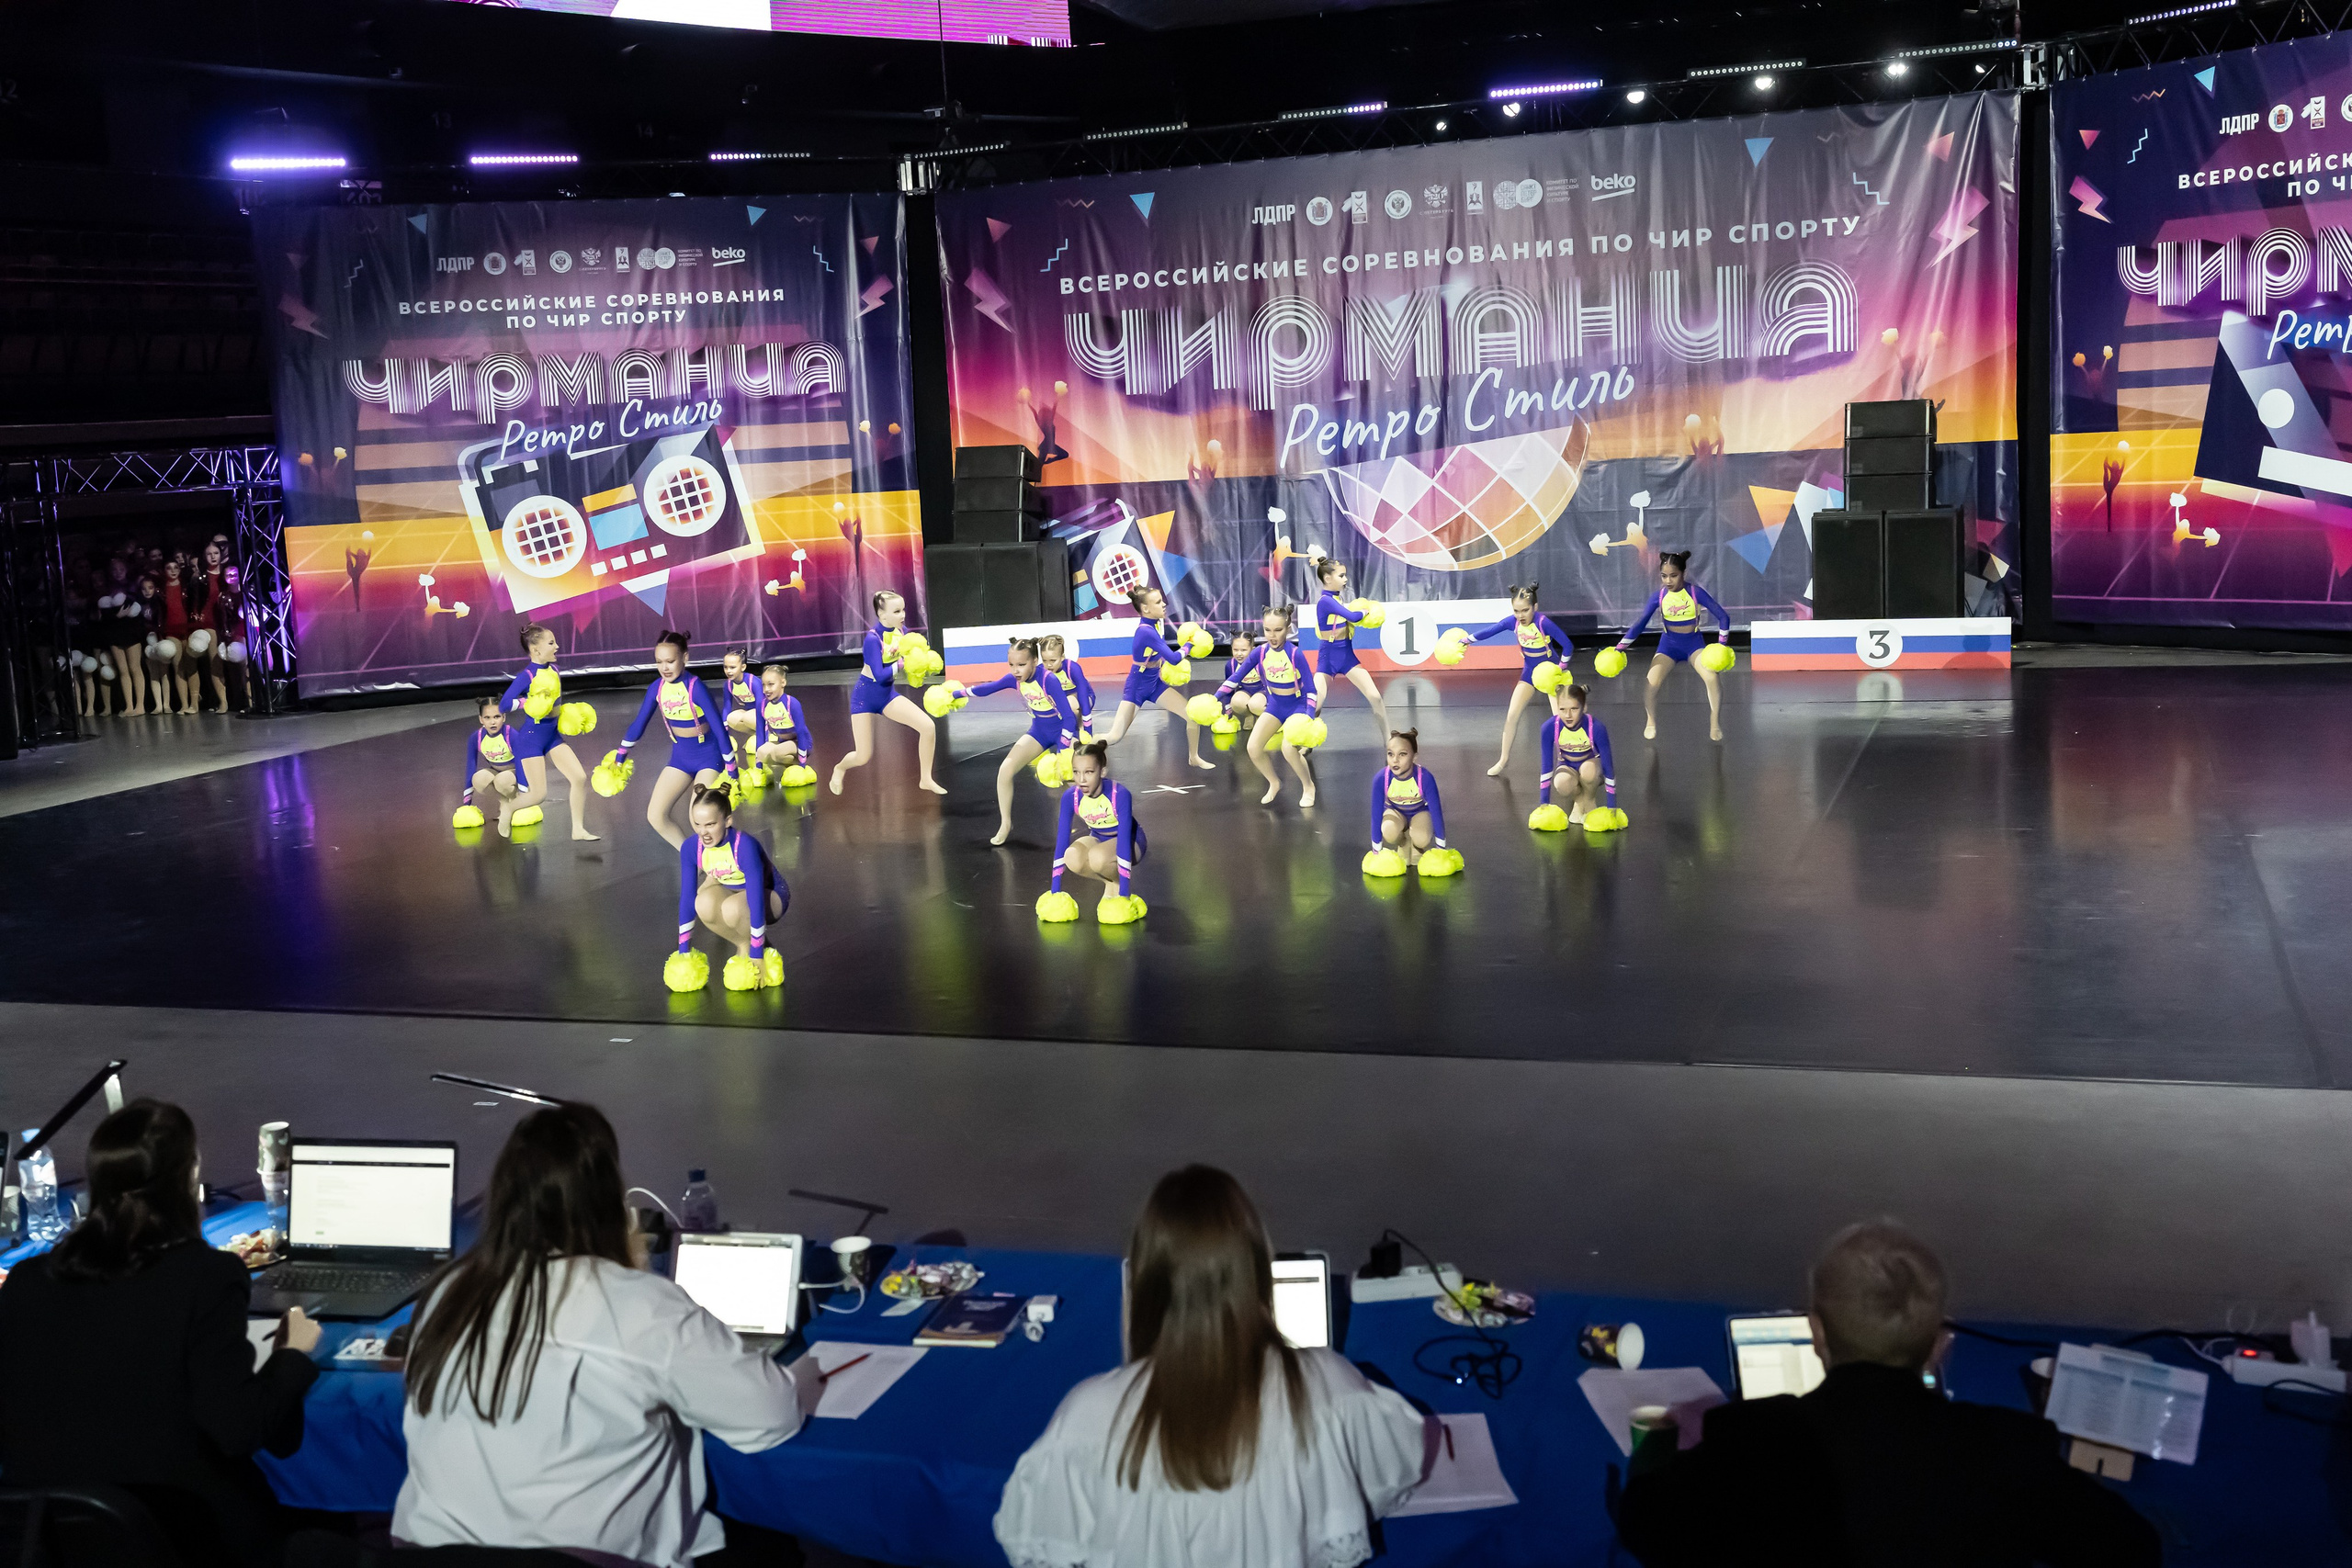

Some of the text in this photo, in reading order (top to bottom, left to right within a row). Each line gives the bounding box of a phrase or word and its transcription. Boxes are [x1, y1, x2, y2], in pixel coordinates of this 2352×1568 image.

[2219, 113, 2259, 135] ЛДПР
[1590, 173, 1635, 191] beko
[2288, 175, 2352, 197] ПО Ч
[1251, 204, 1296, 226] ЛДПР
[711, 247, 746, 260] beko
[1060, 216, 1860, 294] ВСЕРОССИЙСКИЕ СОРЕВНОВАНИЯ ПО ЧИР СПОРТУ
[436, 256, 475, 274] ЛДПР
[399, 288, 786, 315] ВСЕРОССИЙСКИЕ СОРЕВНОВАНИЯ
[506, 310, 687, 329] ПО ЧИР СПОРТУ
[1280, 367, 1634, 468] Ретро Стиль
[500, 399, 723, 459] Ретро Стиль
[1398, 616, 1420, 655] 1
[1869, 630, 1891, 660] 3
